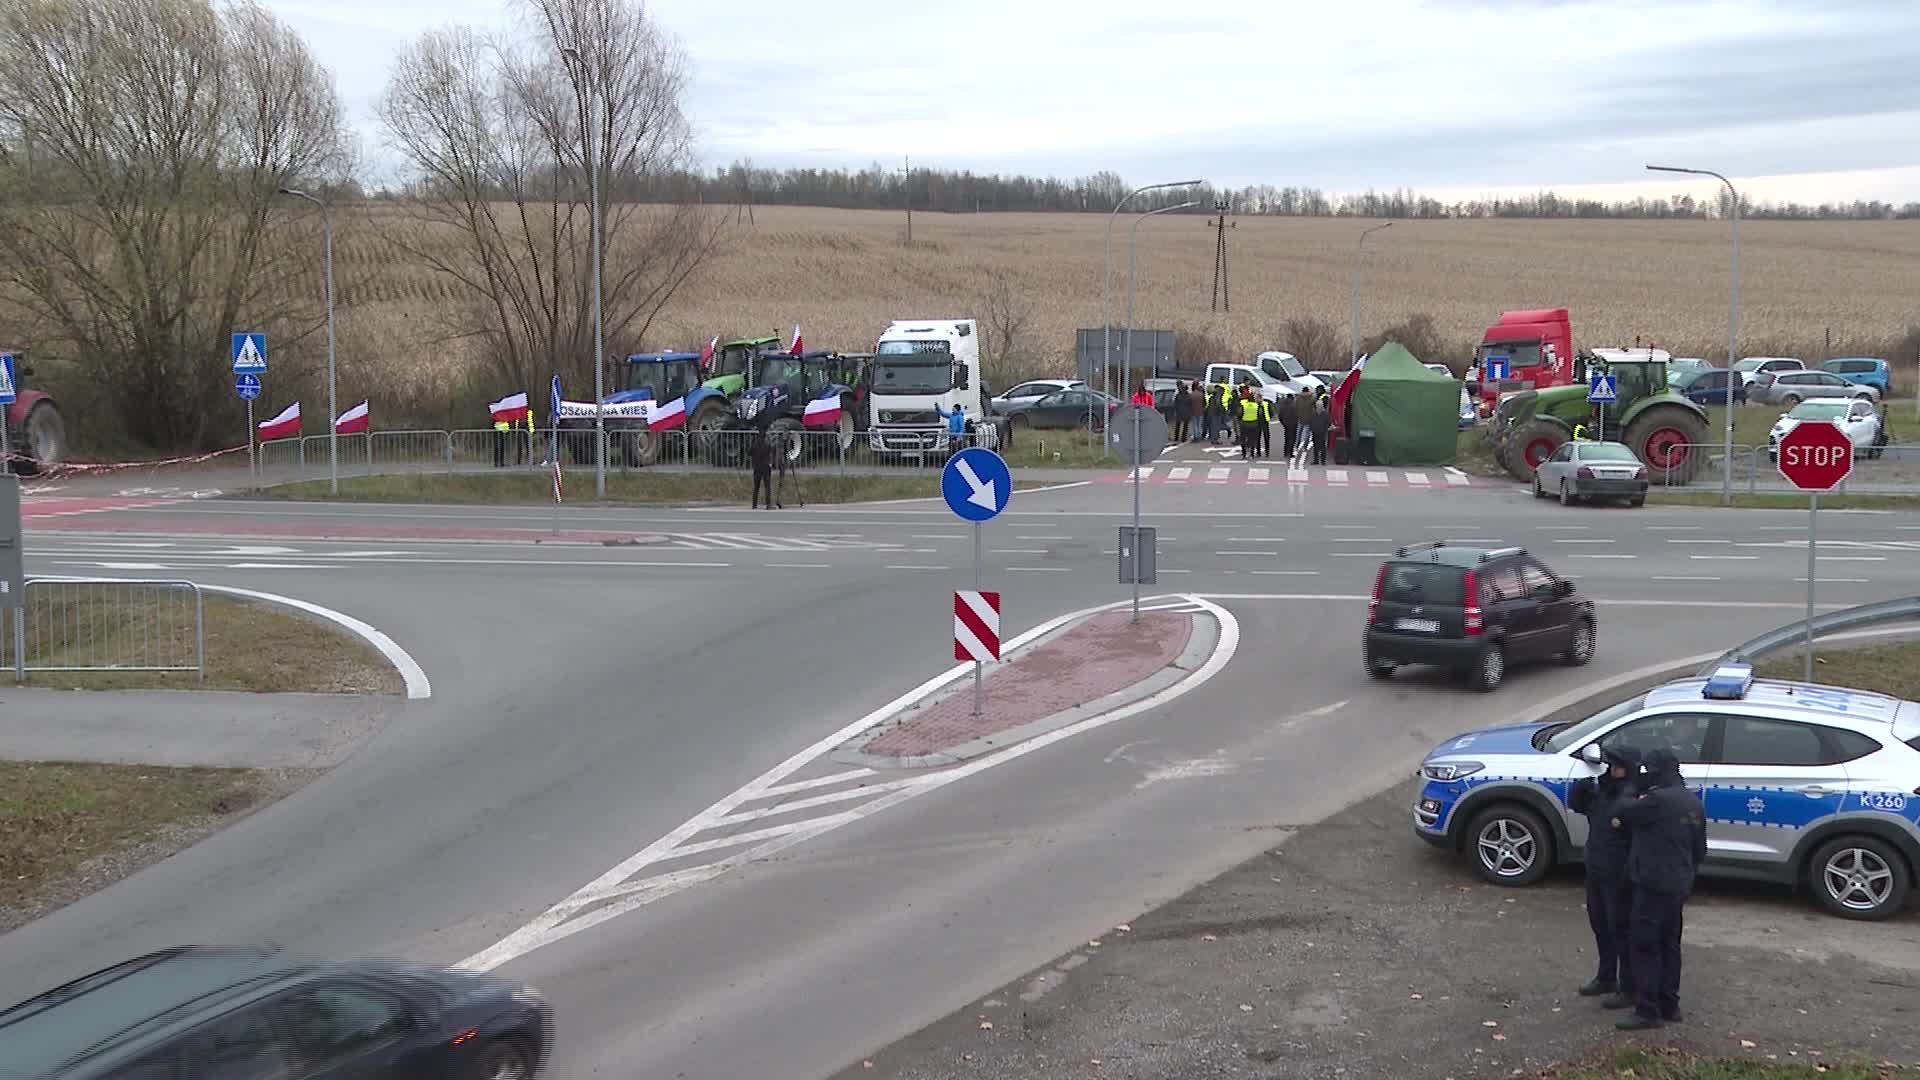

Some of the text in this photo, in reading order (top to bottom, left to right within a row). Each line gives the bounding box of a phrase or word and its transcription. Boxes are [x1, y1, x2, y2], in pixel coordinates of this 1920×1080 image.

[1786, 445, 1846, 466] STOP
[1860, 795, 1904, 808] K 260
